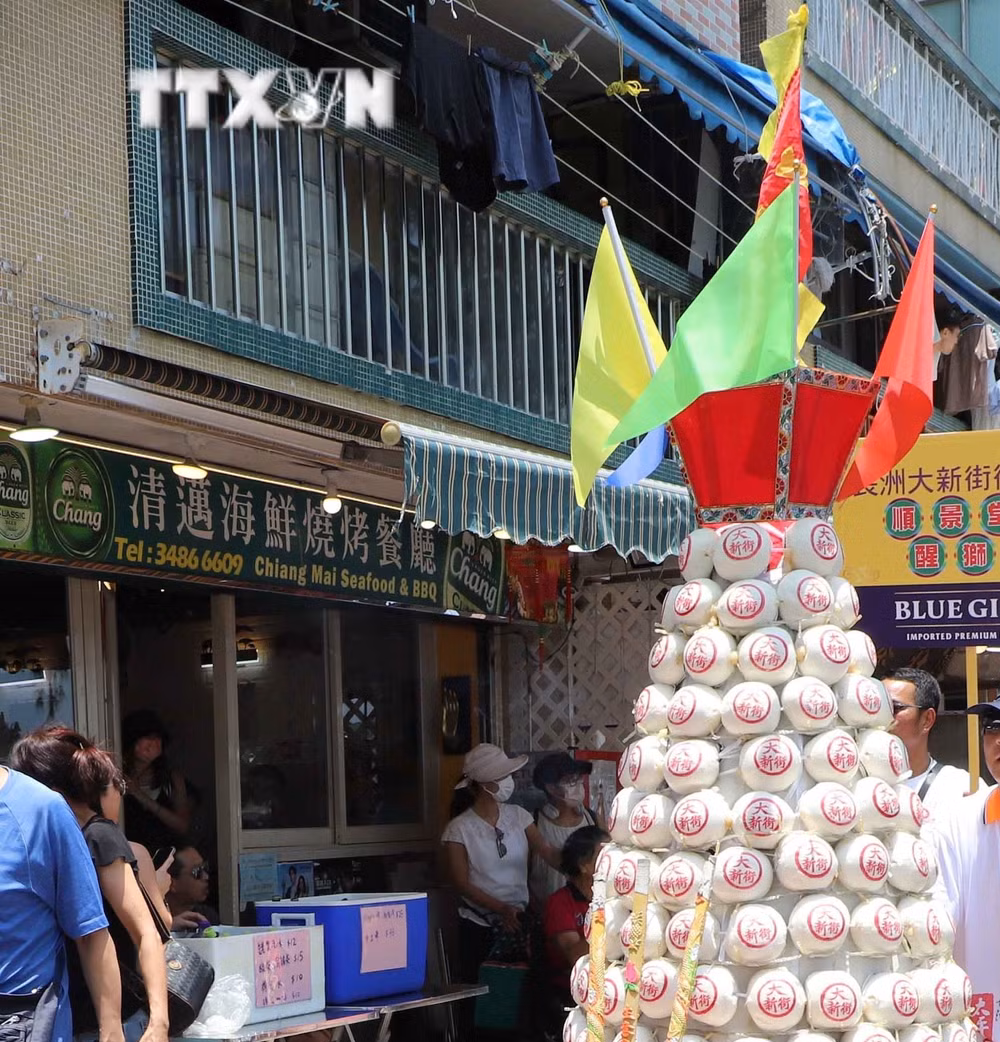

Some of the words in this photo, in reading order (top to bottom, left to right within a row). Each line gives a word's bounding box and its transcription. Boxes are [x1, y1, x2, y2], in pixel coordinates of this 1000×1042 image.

[0, 481, 29, 507] hang
[0, 508, 25, 520] LASSIC
[52, 499, 102, 531] Chang
[128, 464, 437, 575] 清邁海鮮燒烤餐廳
[255, 556, 306, 585] Chiang
[311, 565, 337, 587] Mai
[341, 569, 395, 595] Seafood
[400, 578, 409, 597] &
[412, 579, 438, 603] BBQ
[450, 547, 498, 610] Chang
[894, 599, 963, 620] BLUE
[906, 632, 952, 641] IMPORTED
[955, 631, 998, 640] PREMIUM
